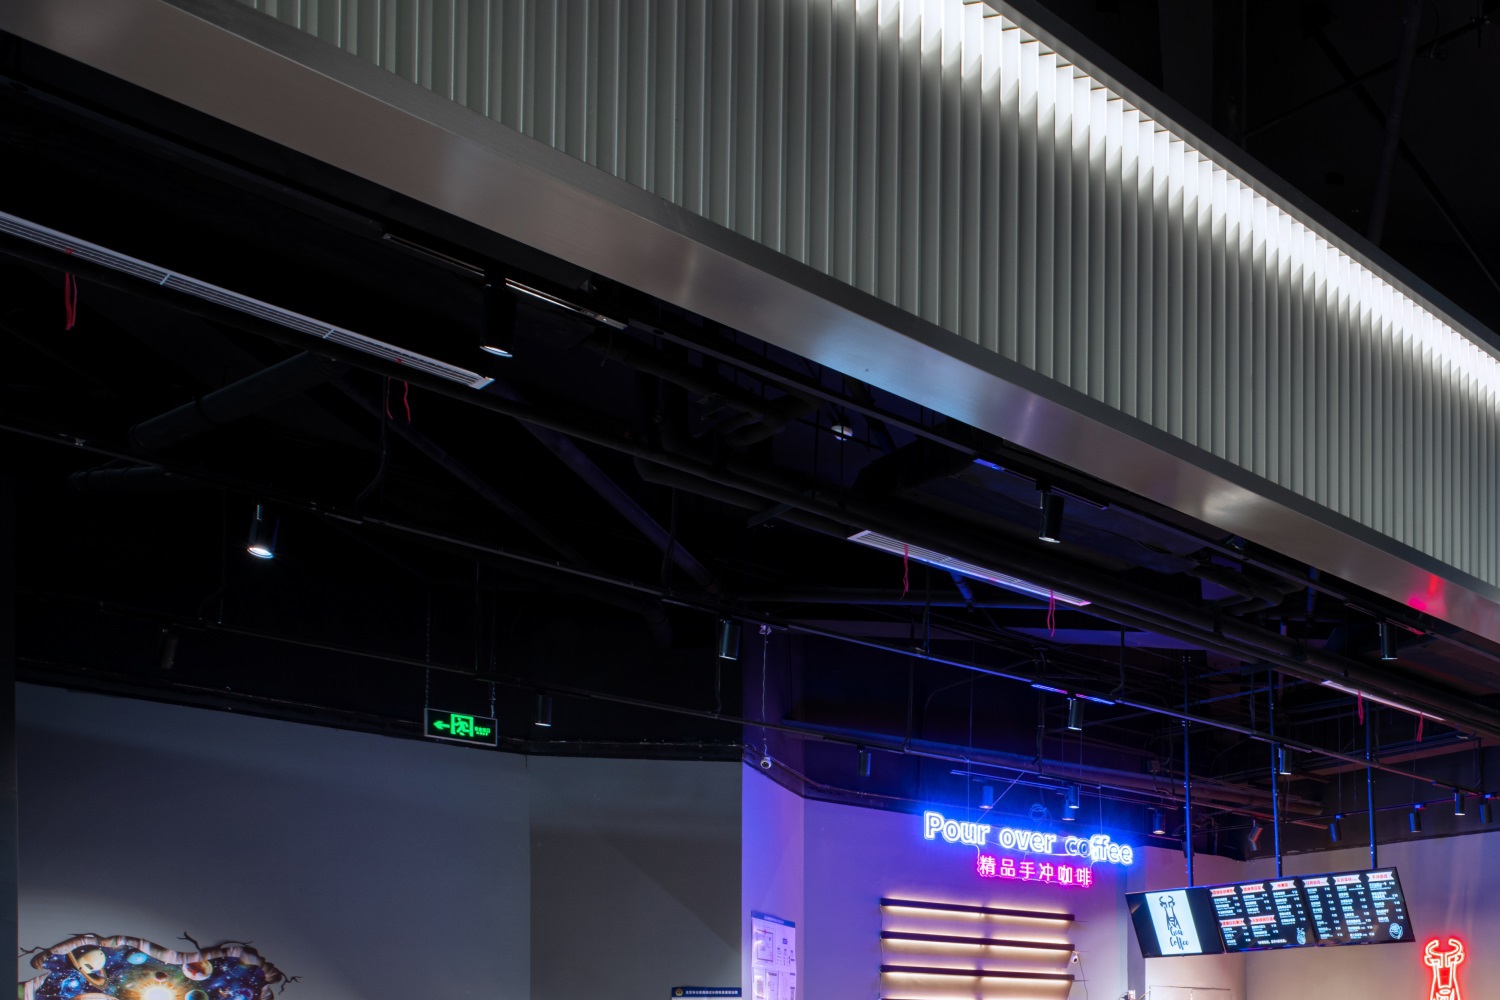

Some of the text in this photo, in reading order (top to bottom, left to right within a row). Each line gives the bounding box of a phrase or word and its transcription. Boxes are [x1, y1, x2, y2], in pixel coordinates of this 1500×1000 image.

[924, 810, 1133, 865] Pour over coffee
[979, 856, 1093, 887] 精品手冲咖啡
